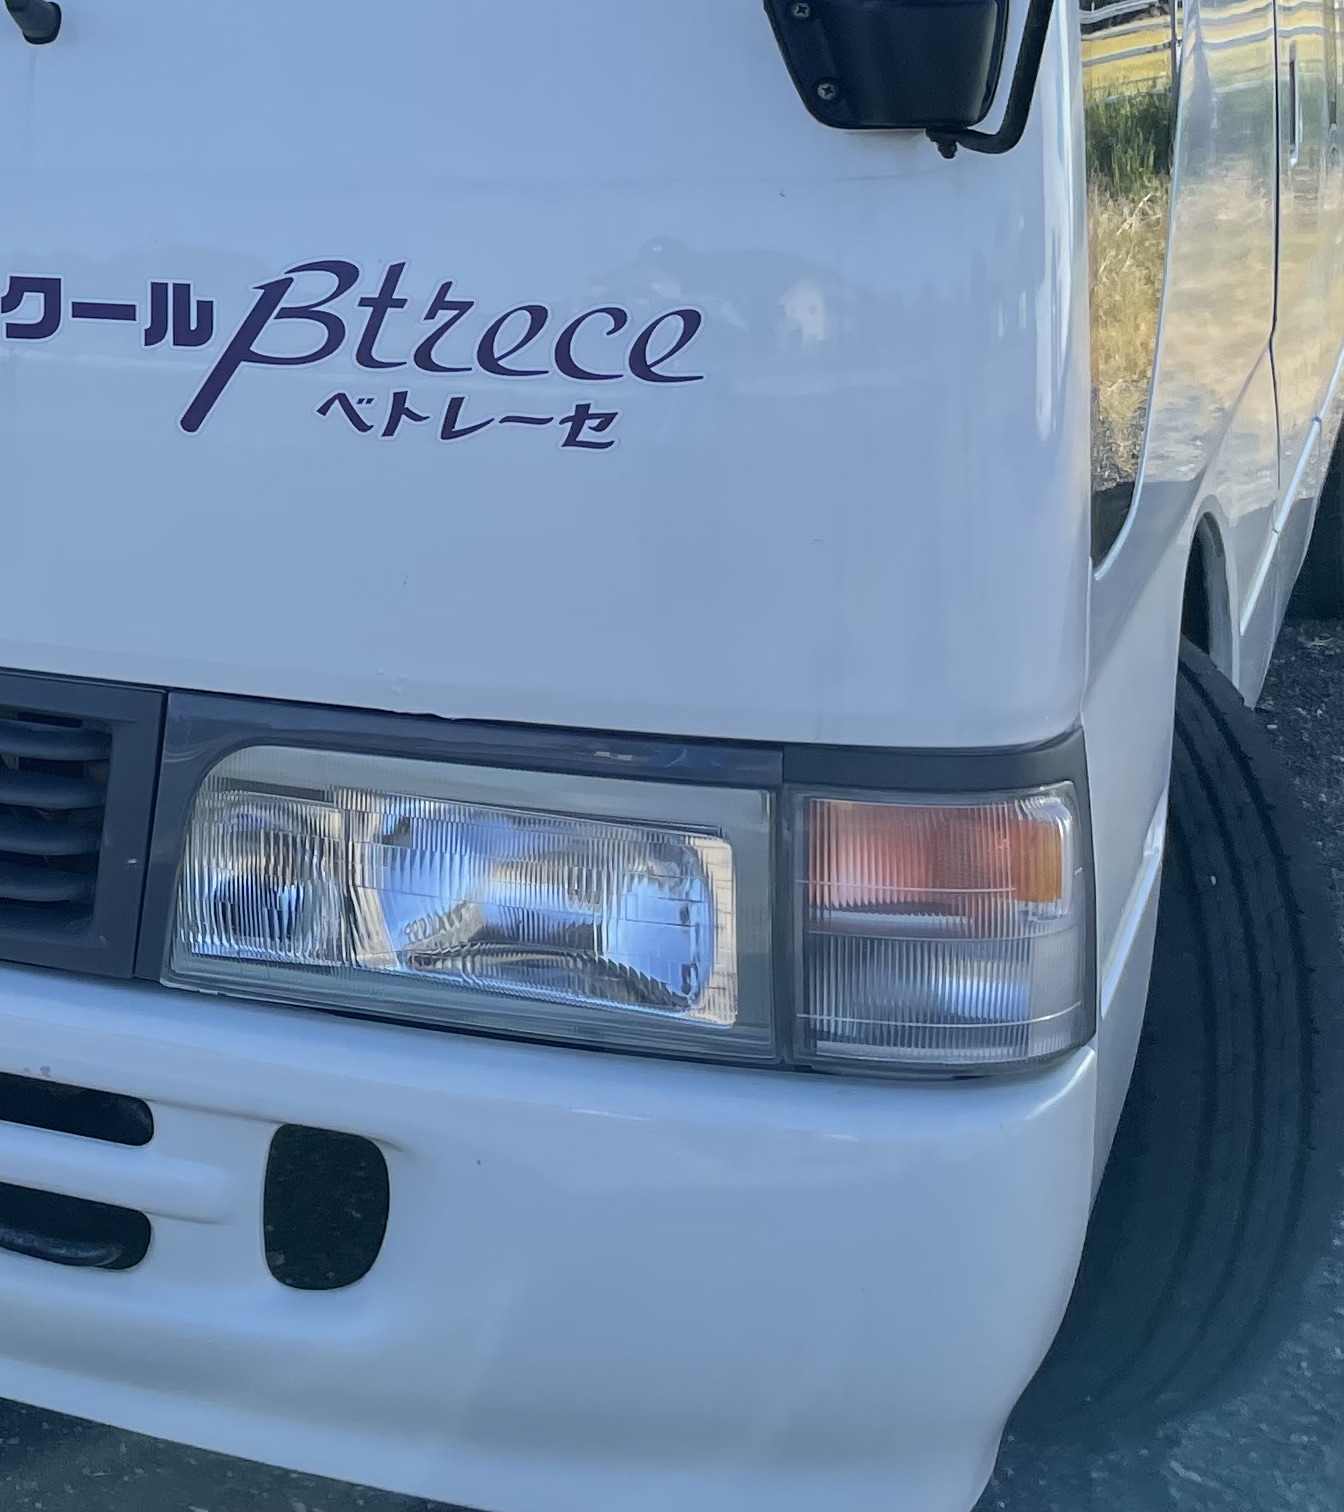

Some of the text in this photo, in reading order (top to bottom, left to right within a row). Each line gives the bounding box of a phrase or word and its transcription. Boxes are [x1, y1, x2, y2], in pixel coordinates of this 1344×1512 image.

[317, 390, 620, 450] ベトレーセ
